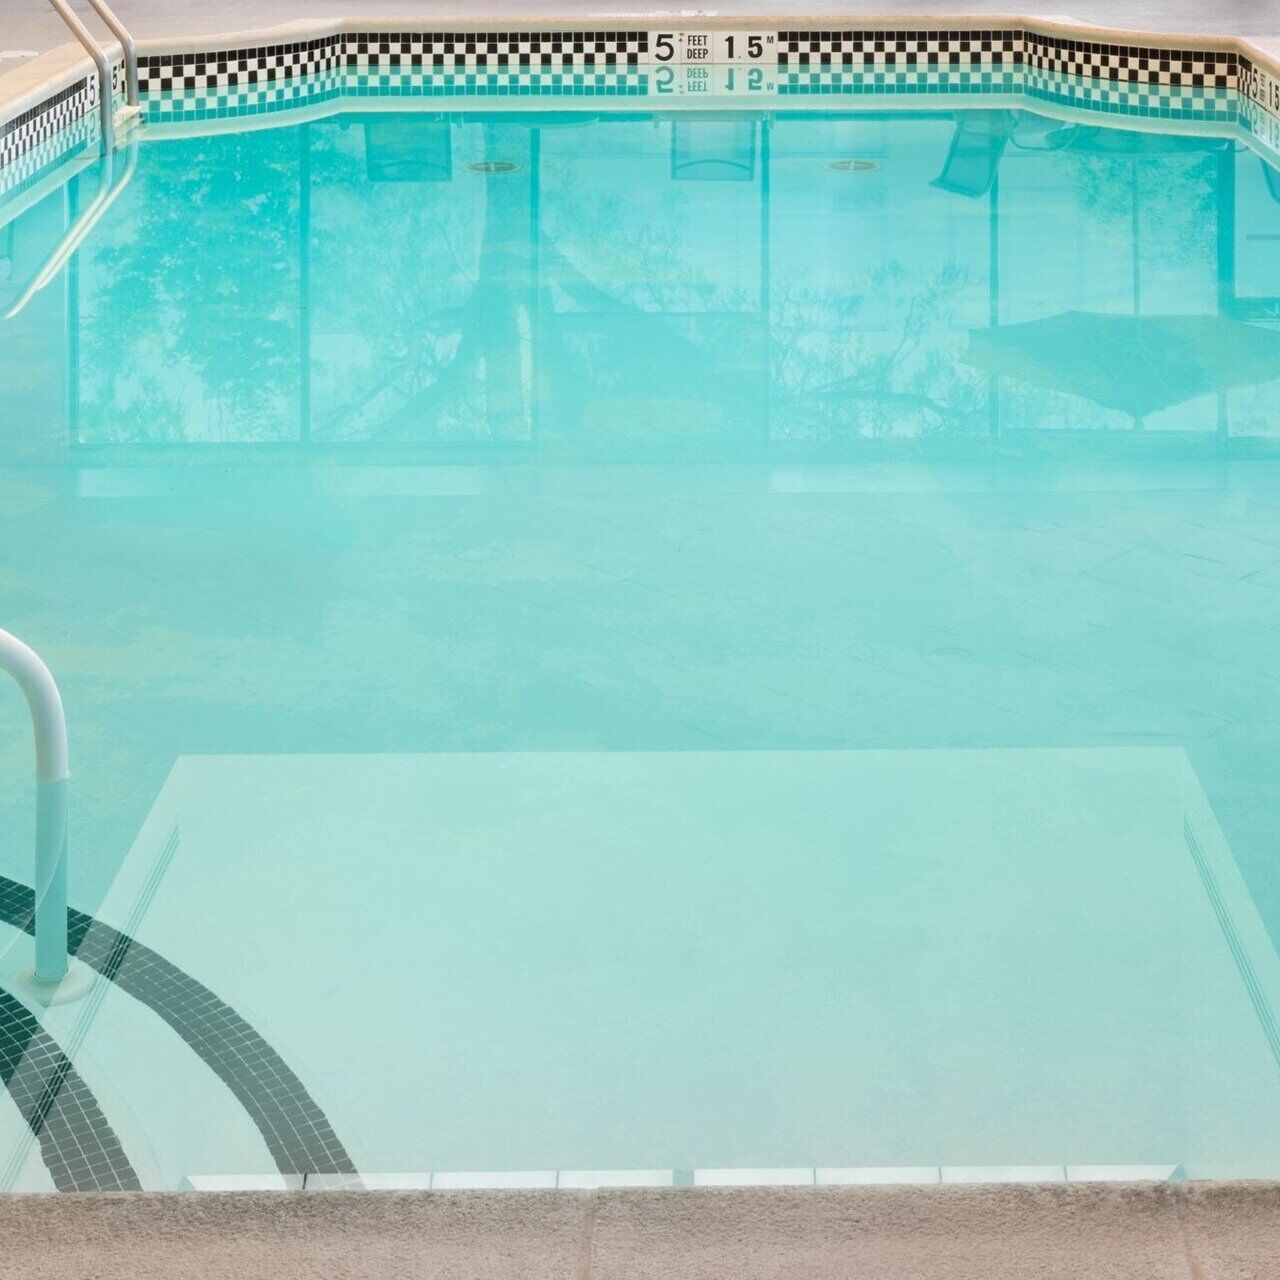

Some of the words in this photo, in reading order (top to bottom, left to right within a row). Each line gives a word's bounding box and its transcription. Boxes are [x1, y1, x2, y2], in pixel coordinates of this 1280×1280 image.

[687, 35, 708, 46] FEET
[767, 36, 774, 44] M
[654, 34, 675, 62] 5
[686, 48, 709, 59] DEEP
[89, 74, 96, 107] 5
